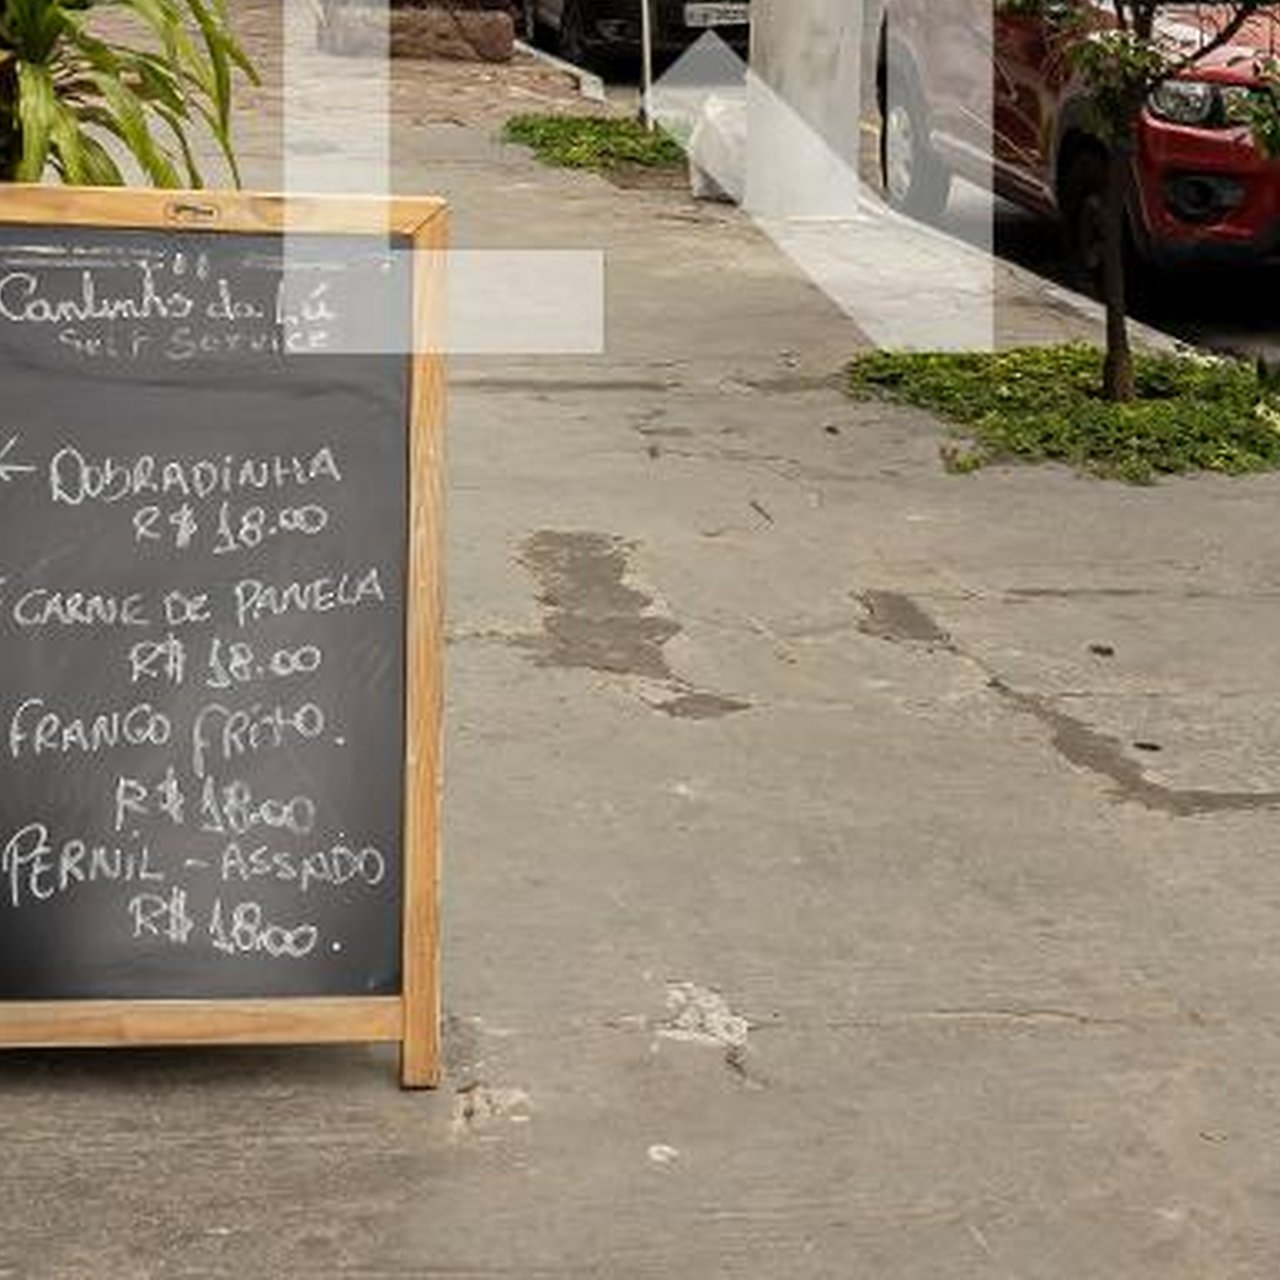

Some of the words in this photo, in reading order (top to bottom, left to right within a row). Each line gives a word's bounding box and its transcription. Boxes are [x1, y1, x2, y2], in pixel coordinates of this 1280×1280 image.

[132, 504, 197, 548] R$
[14, 588, 148, 624] CARNE
[163, 592, 211, 622] DE
[234, 570, 385, 627] PANELA
[128, 633, 185, 683] R$
[208, 638, 322, 688] 18.00
[9, 699, 171, 757] FRANGO
[116, 767, 184, 831] R$
[2, 823, 165, 907] PERNIL
[128, 886, 194, 943] R$
